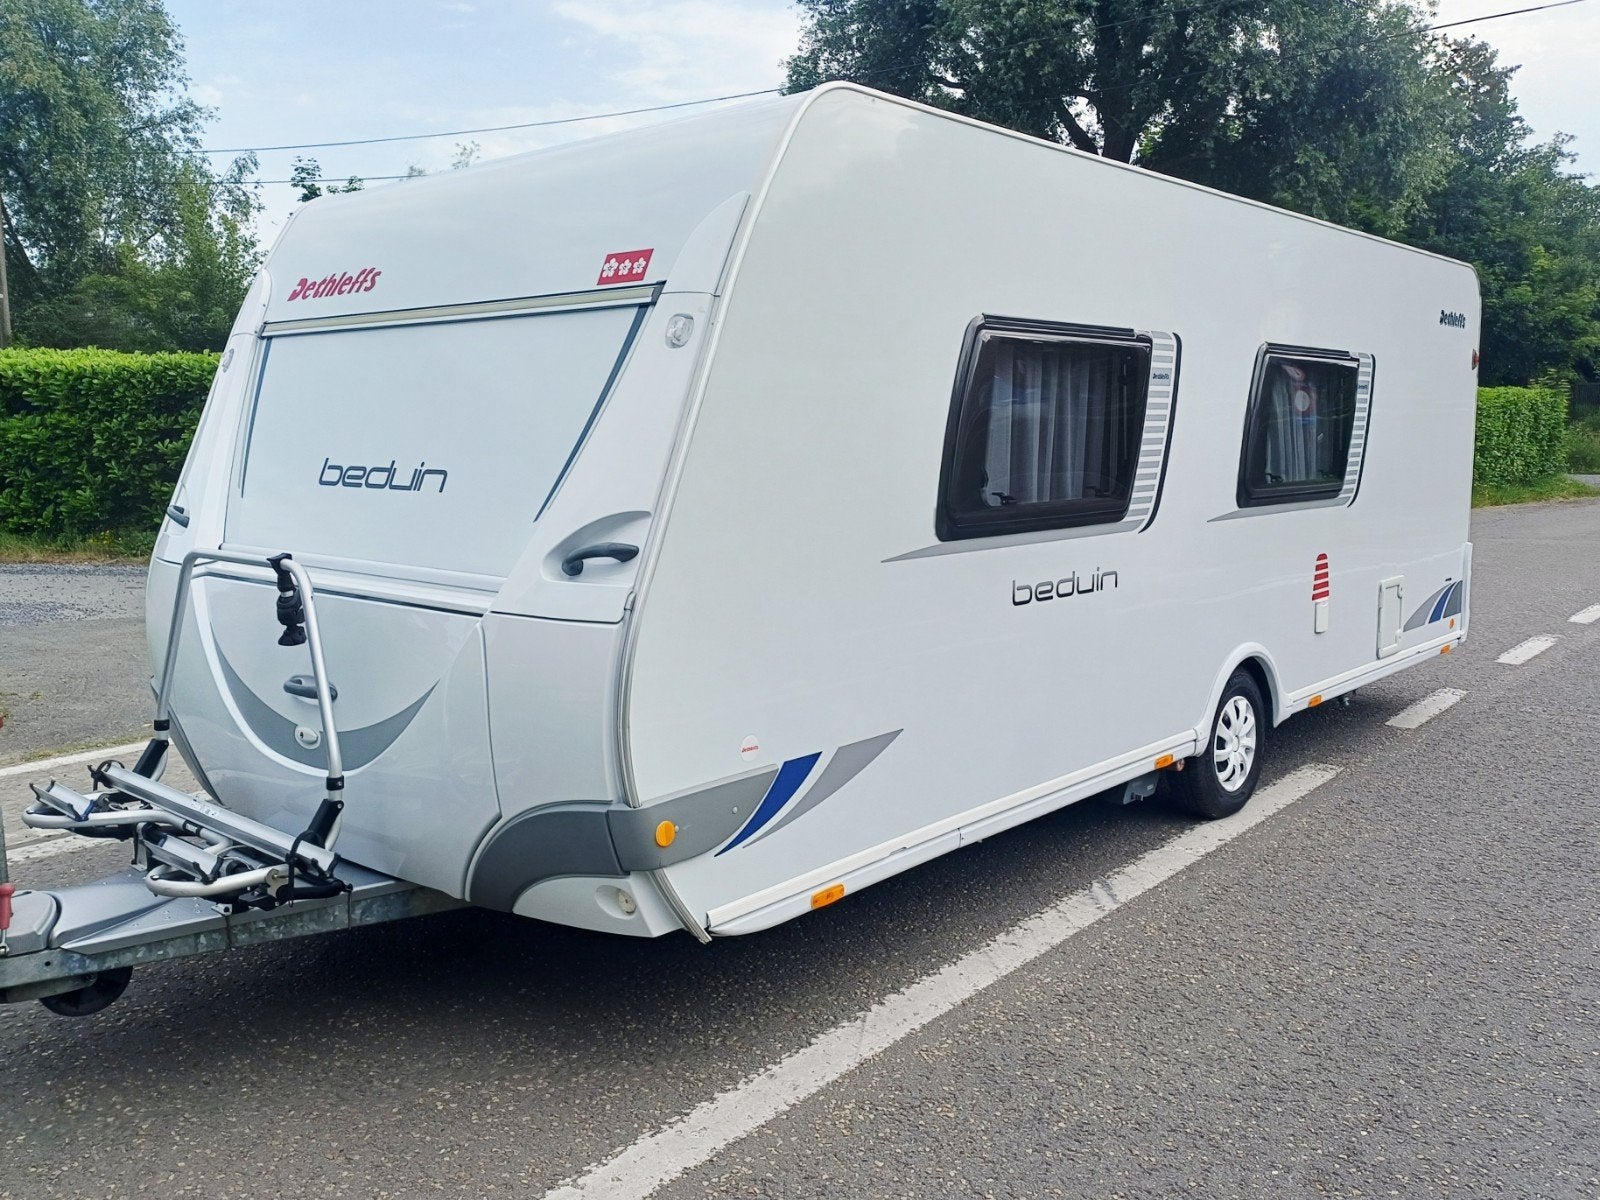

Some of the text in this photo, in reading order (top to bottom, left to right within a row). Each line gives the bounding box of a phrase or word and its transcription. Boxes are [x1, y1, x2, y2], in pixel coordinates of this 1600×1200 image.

[287, 267, 382, 302] Dethleffs
[318, 457, 448, 493] beduin
[1012, 566, 1118, 606] beduin
